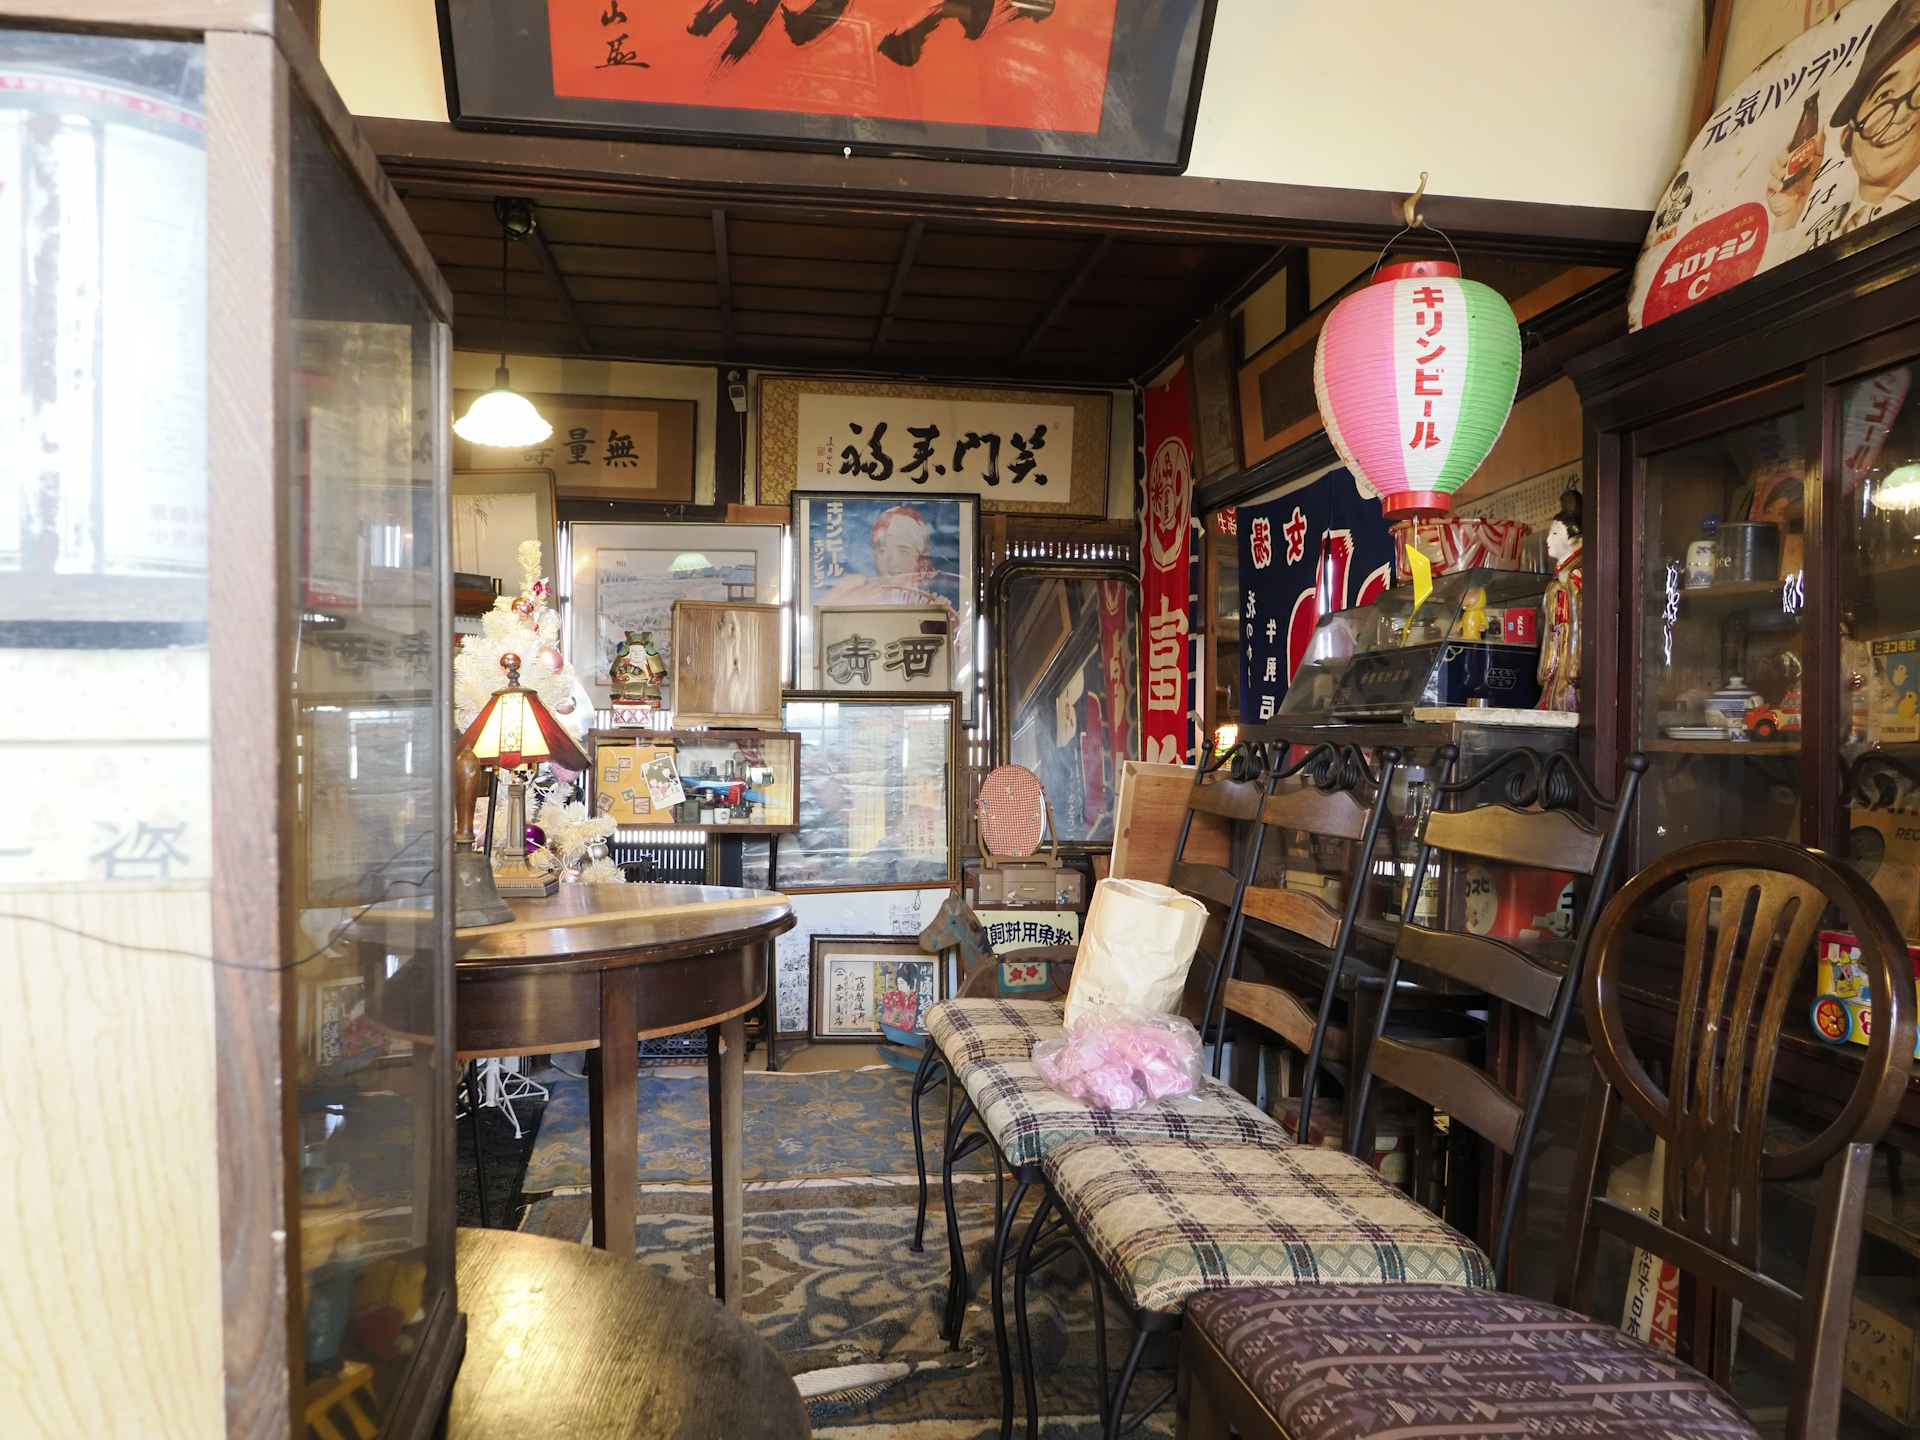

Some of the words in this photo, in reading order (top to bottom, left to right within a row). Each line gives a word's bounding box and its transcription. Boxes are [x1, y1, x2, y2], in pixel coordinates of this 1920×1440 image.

[1660, 227, 1759, 288] オロナミン
[1688, 272, 1711, 300] C
[1409, 286, 1446, 451] キリンビール
[814, 539, 825, 588] キリンレモン
[826, 502, 844, 577] キリンビール
[1874, 639, 1917, 655] ヒヨコ電球
